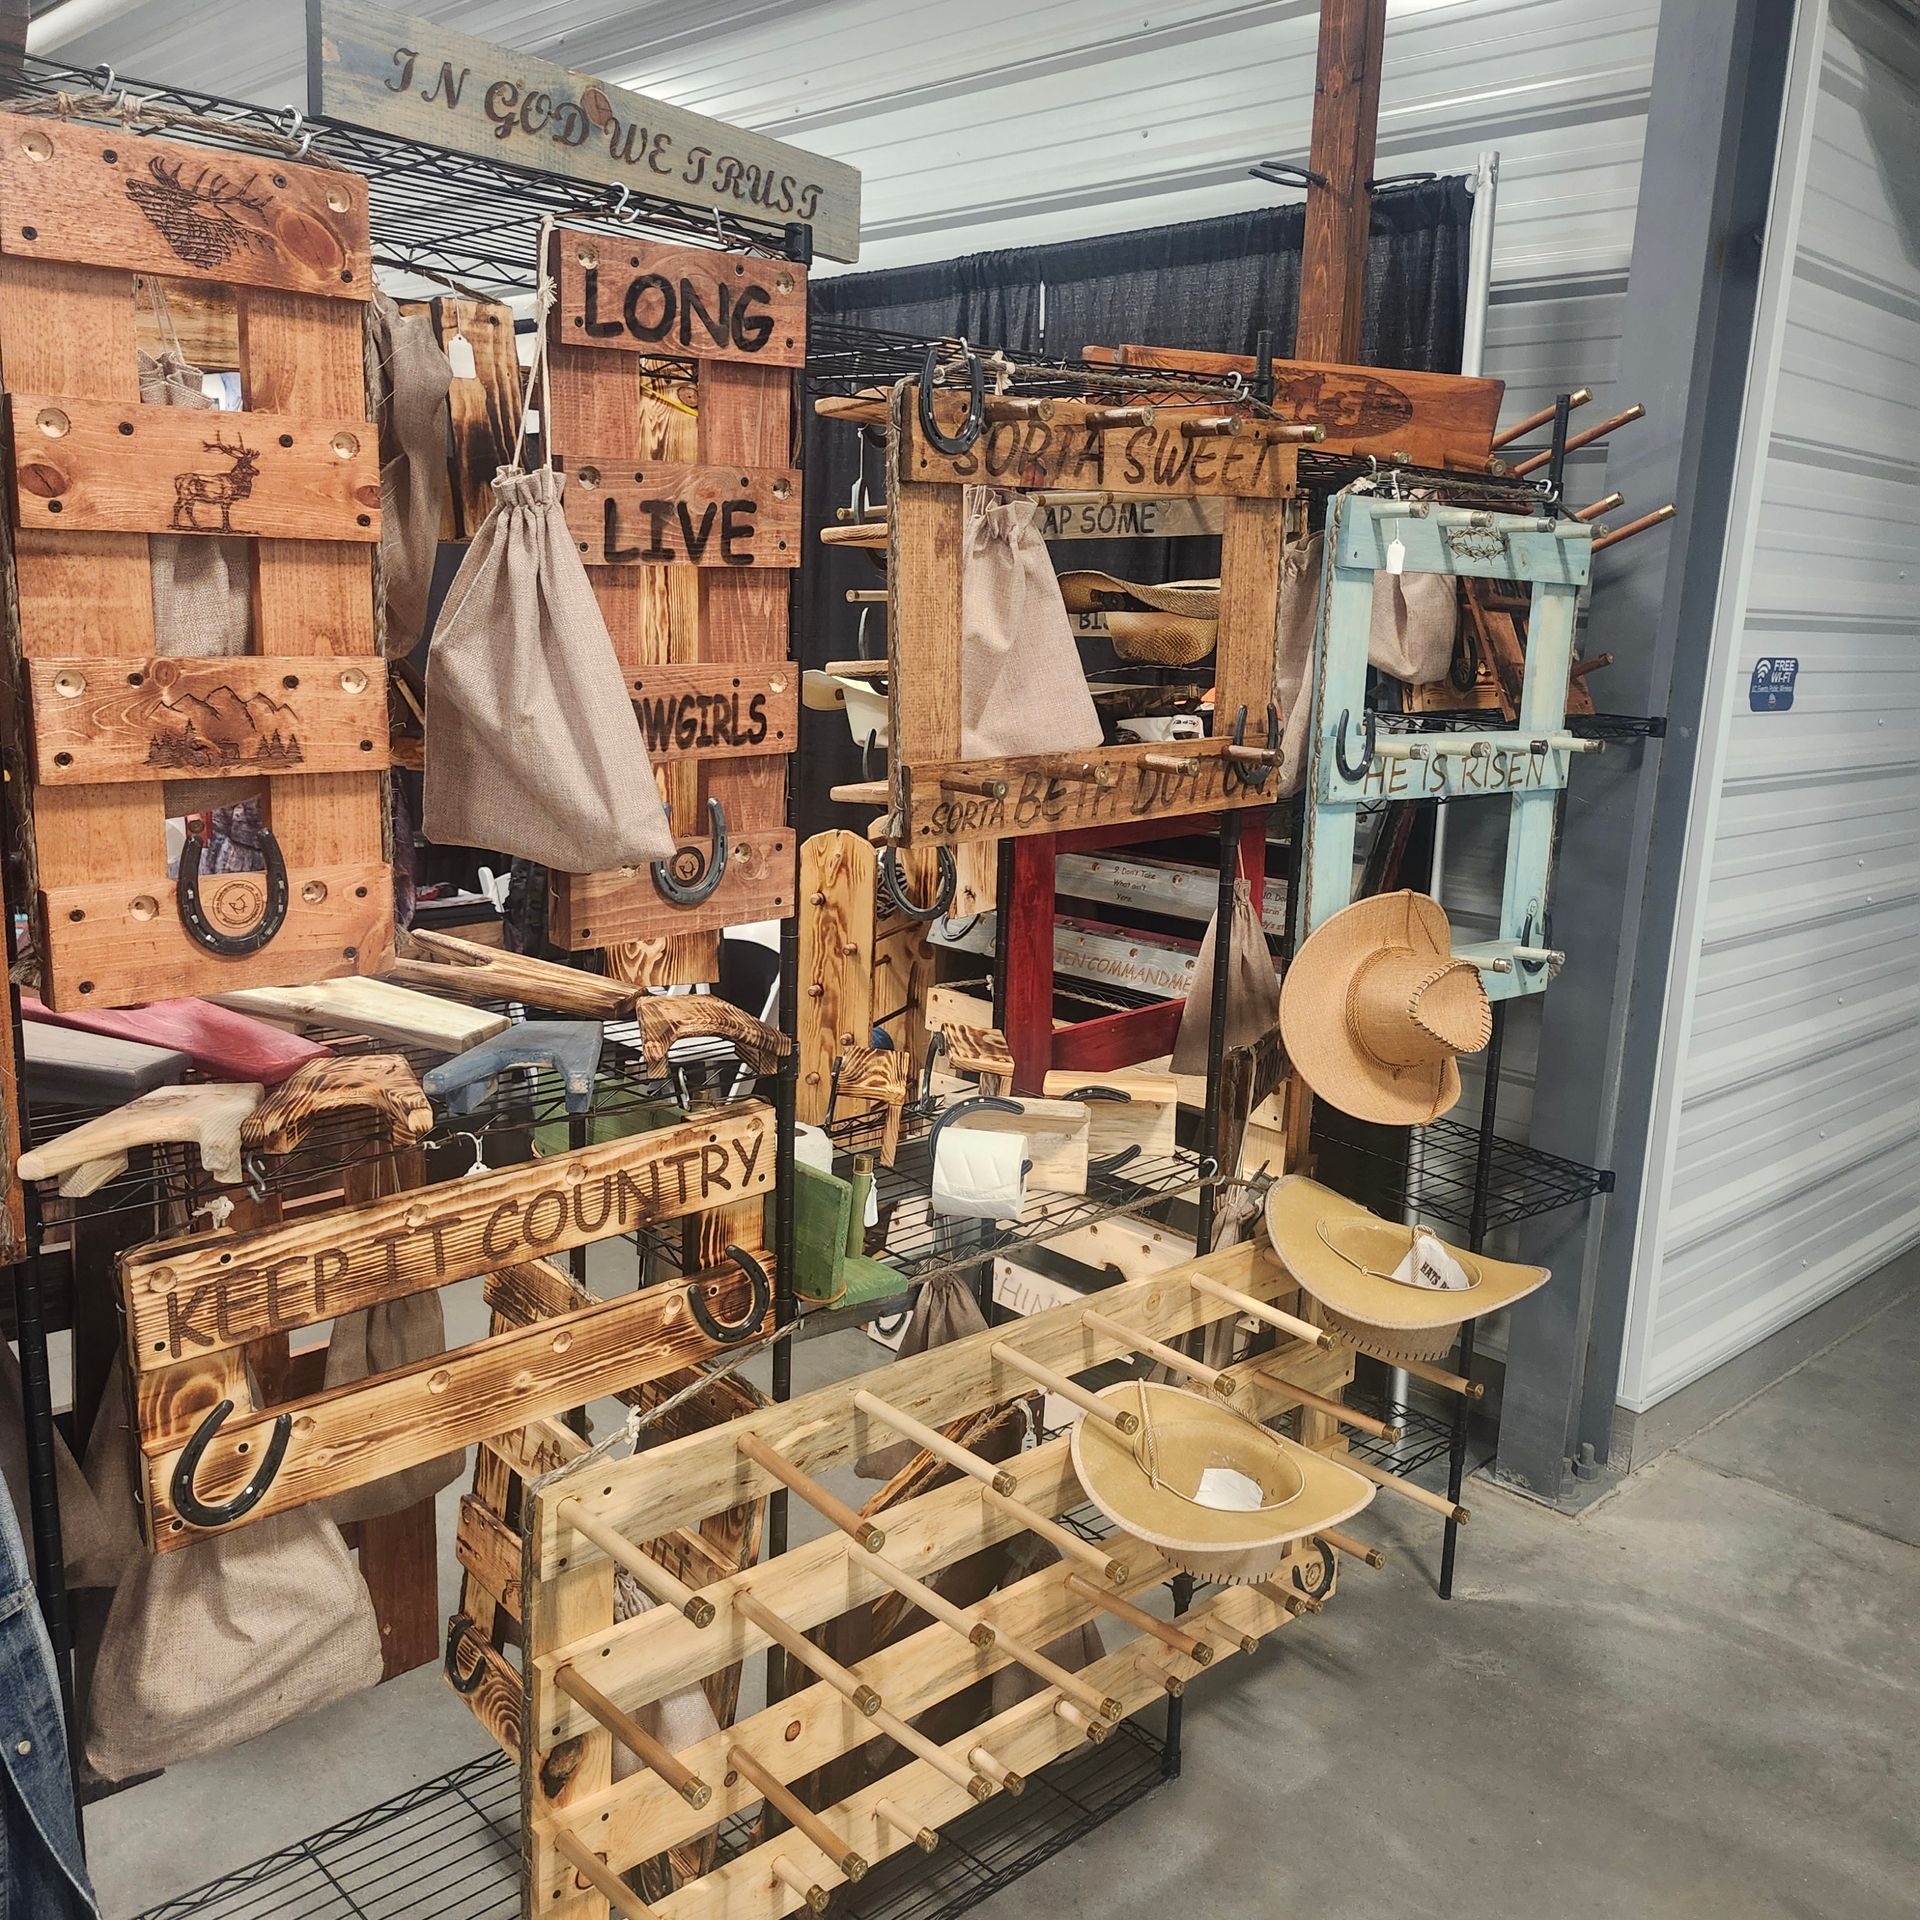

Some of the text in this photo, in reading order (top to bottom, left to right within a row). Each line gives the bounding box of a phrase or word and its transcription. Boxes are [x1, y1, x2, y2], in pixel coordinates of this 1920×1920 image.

[384, 47, 824, 220] IN GOD WE TRUST
[584, 268, 774, 352] LONG
[952, 419, 1269, 488] SORTA SWEET
[603, 497, 757, 565] LIVE
[1080, 502, 1156, 534] SOME
[1774, 660, 1796, 671] FREE
[630, 691, 768, 752] WGIRLS
[931, 796, 1005, 836] SORTA
[1013, 761, 1127, 829] BETH
[1363, 751, 1548, 795] HE IS RISEN
[1113, 878, 1131, 888] What
[168, 1131, 765, 1359] KEEP IT COUNTRY
[1420, 1261, 1441, 1286] HATS
